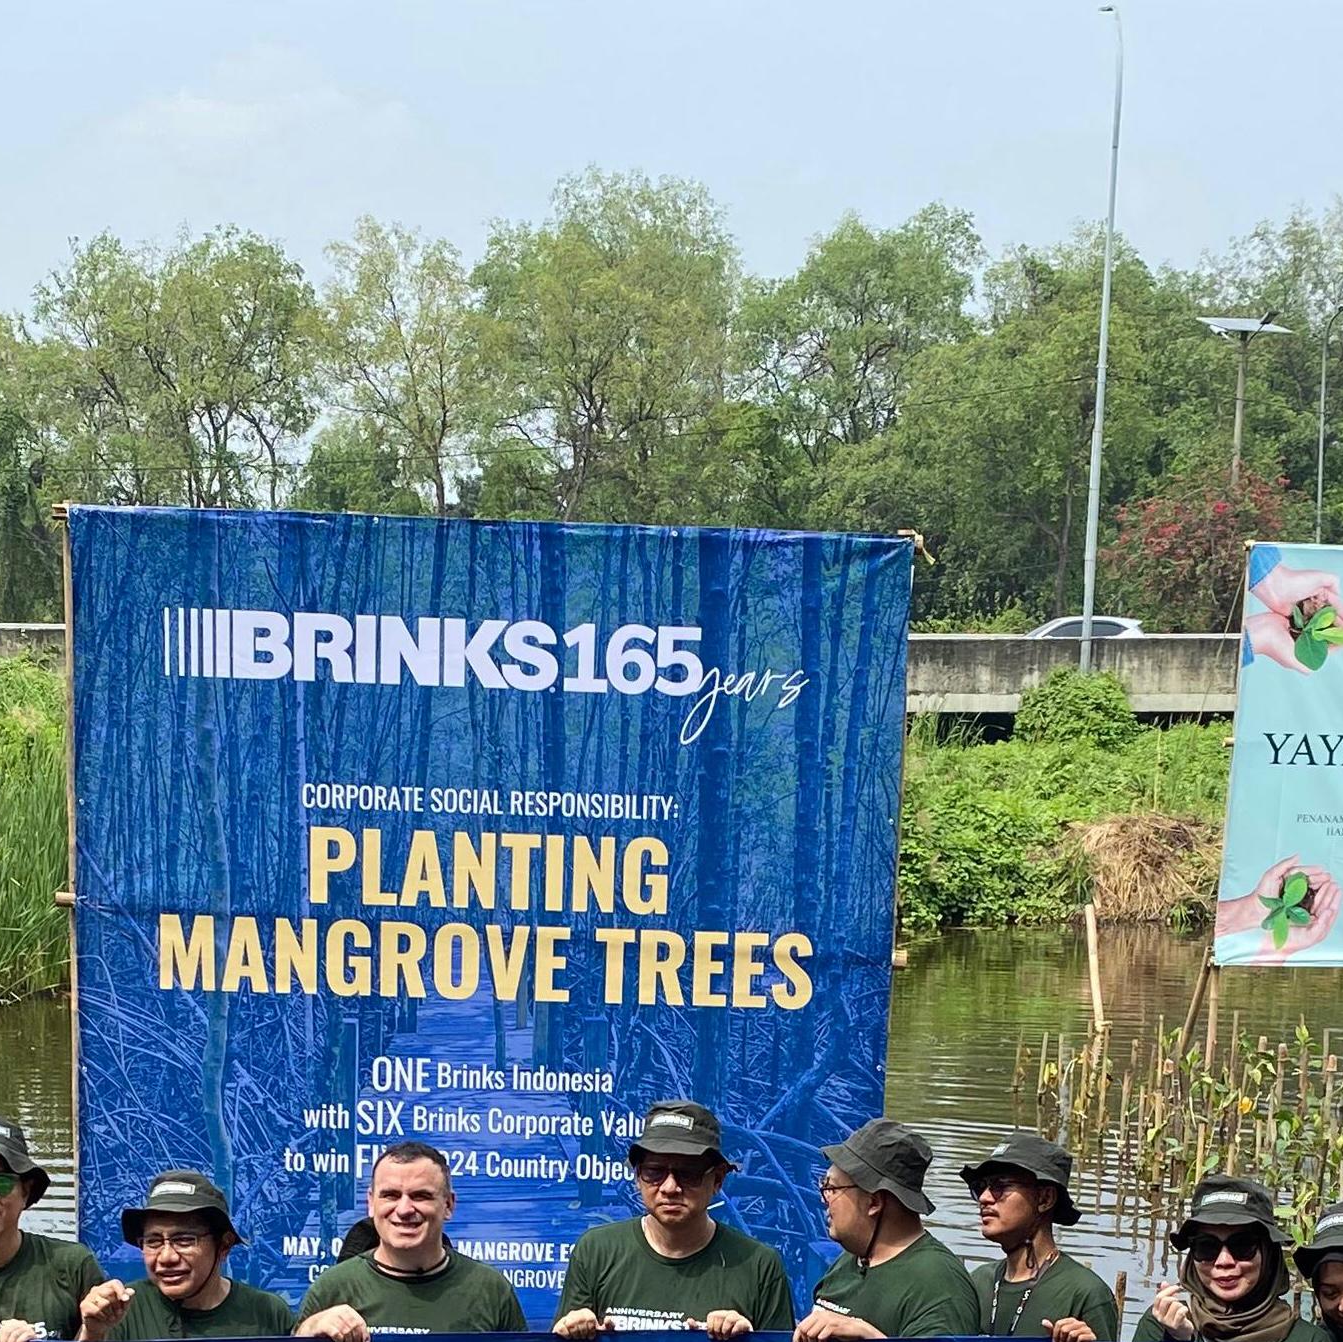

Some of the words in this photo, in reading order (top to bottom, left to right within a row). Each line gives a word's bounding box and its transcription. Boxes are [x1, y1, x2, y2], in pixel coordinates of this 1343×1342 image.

[681, 664, 810, 745] years
[301, 782, 425, 814] CORPORATE
[429, 787, 504, 817] SOCIAL
[509, 791, 681, 821] RESPONSIBILITY:
[308, 825, 669, 916] PLANTING
[159, 911, 570, 1004] MANGROVE
[595, 927, 816, 1010] TREES
[370, 1055, 432, 1093] ONE
[437, 1062, 506, 1091] Brinks
[512, 1063, 614, 1094] Indonesia
[303, 1104, 350, 1130] with
[356, 1100, 406, 1136] SIX
[412, 1104, 482, 1134] Brinks
[487, 1107, 594, 1141] Corporate
[283, 1149, 306, 1173] to
[312, 1148, 351, 1174] win
[485, 1150, 570, 1183] Country
[283, 1236, 327, 1260] MAY,
[459, 1241, 555, 1263] MANGROVE
[605, 1306, 685, 1319] ANNIVERSARY
